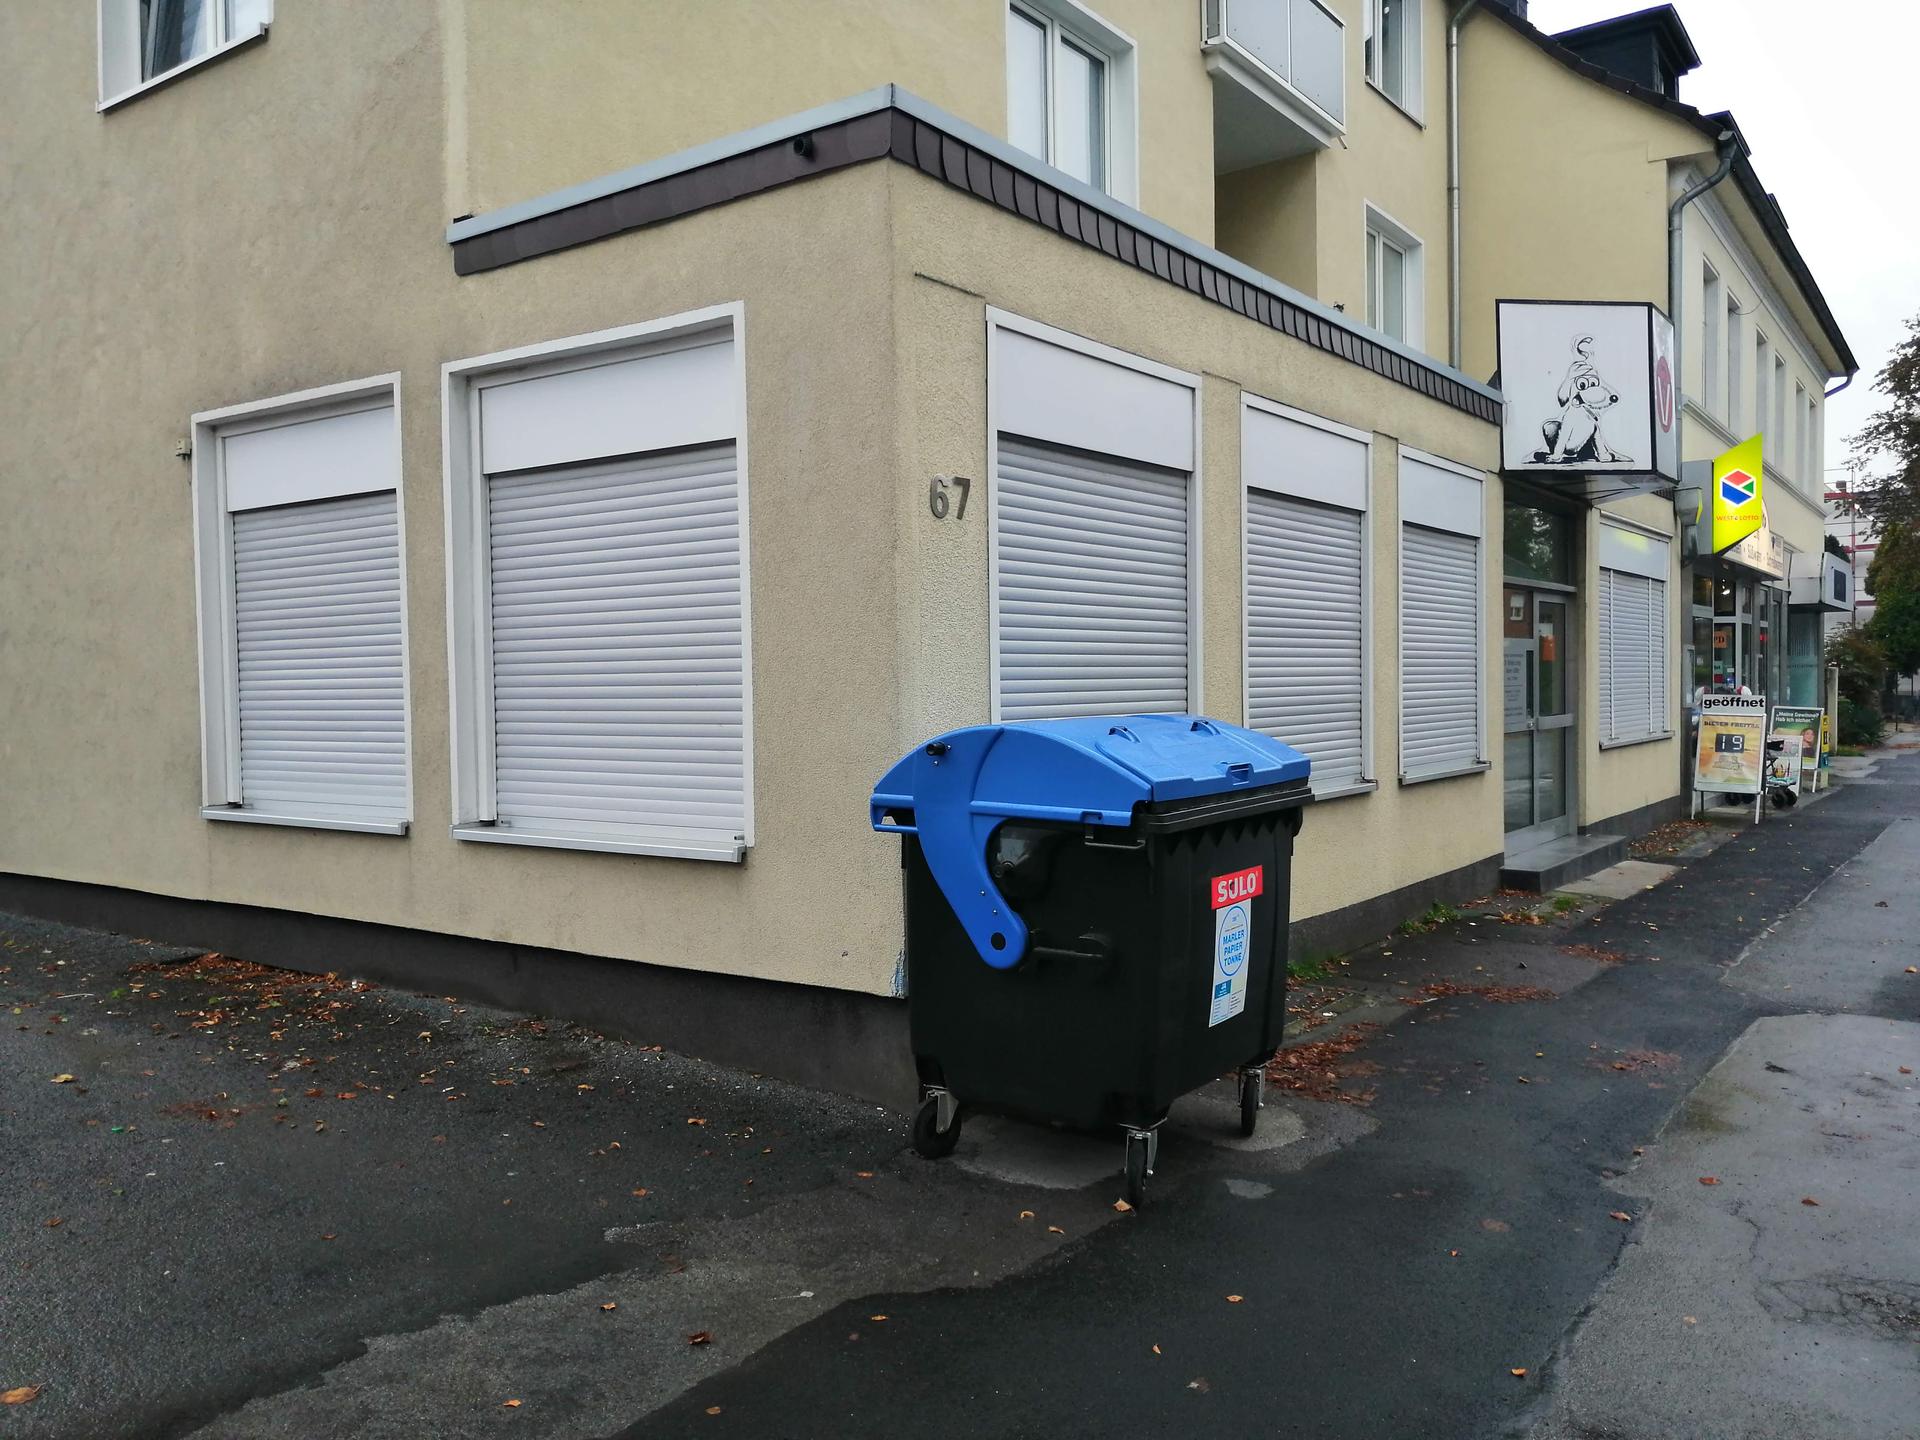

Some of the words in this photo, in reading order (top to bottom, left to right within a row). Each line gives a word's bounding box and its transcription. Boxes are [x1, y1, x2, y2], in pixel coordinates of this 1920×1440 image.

[930, 474, 971, 520] 67
[1704, 697, 1765, 708] geöffnet
[1722, 735, 1743, 751] 19
[1217, 872, 1257, 903] SULO
[1223, 930, 1245, 944] MARLER
[1224, 942, 1243, 955] PAPIER
[1224, 953, 1242, 966] TONNE
